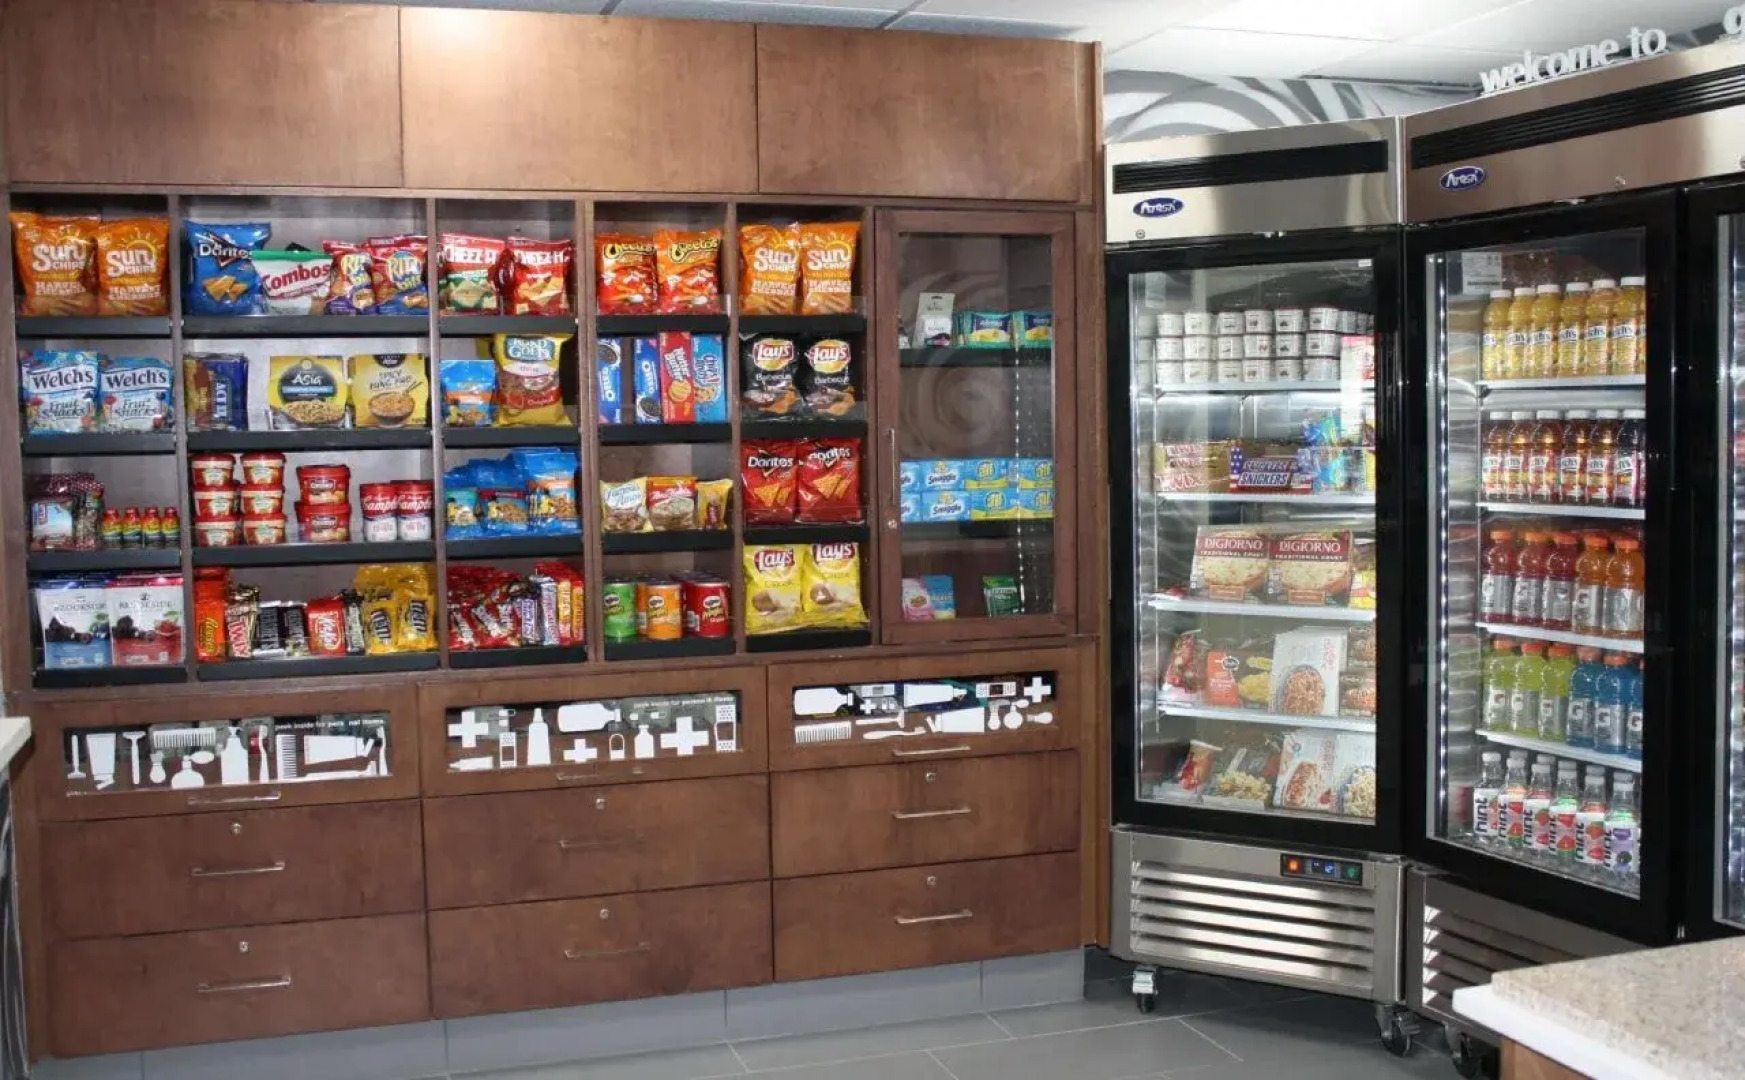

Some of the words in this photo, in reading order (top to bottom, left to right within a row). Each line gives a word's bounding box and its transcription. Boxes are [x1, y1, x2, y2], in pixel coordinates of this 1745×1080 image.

[1480, 38, 1620, 92] welcome
[1628, 26, 1667, 60] to
[32, 243, 87, 272] Sun
[106, 250, 157, 278] Sun
[754, 246, 798, 271] Sun
[807, 247, 852, 271] Sun
[261, 264, 331, 292] Combos
[33, 368, 94, 389] Welch's
[105, 368, 167, 389] Welch's
[291, 373, 322, 386] Asia
[602, 366, 617, 402] OREO
[641, 360, 655, 395] OREO
[748, 456, 795, 468] Doritos
[927, 473, 957, 485] Snuggle
[1239, 473, 1289, 485] SNICKERS
[933, 504, 962, 515] Snuggle
[1204, 538, 1263, 550] DIGIORNO
[1279, 541, 1341, 552] DIGIORNO
[227, 620, 249, 658] TWIX
[1570, 701, 1584, 720] G
[1597, 708, 1611, 727] G
[293, 721, 315, 729] inside
[1628, 711, 1643, 731] G
